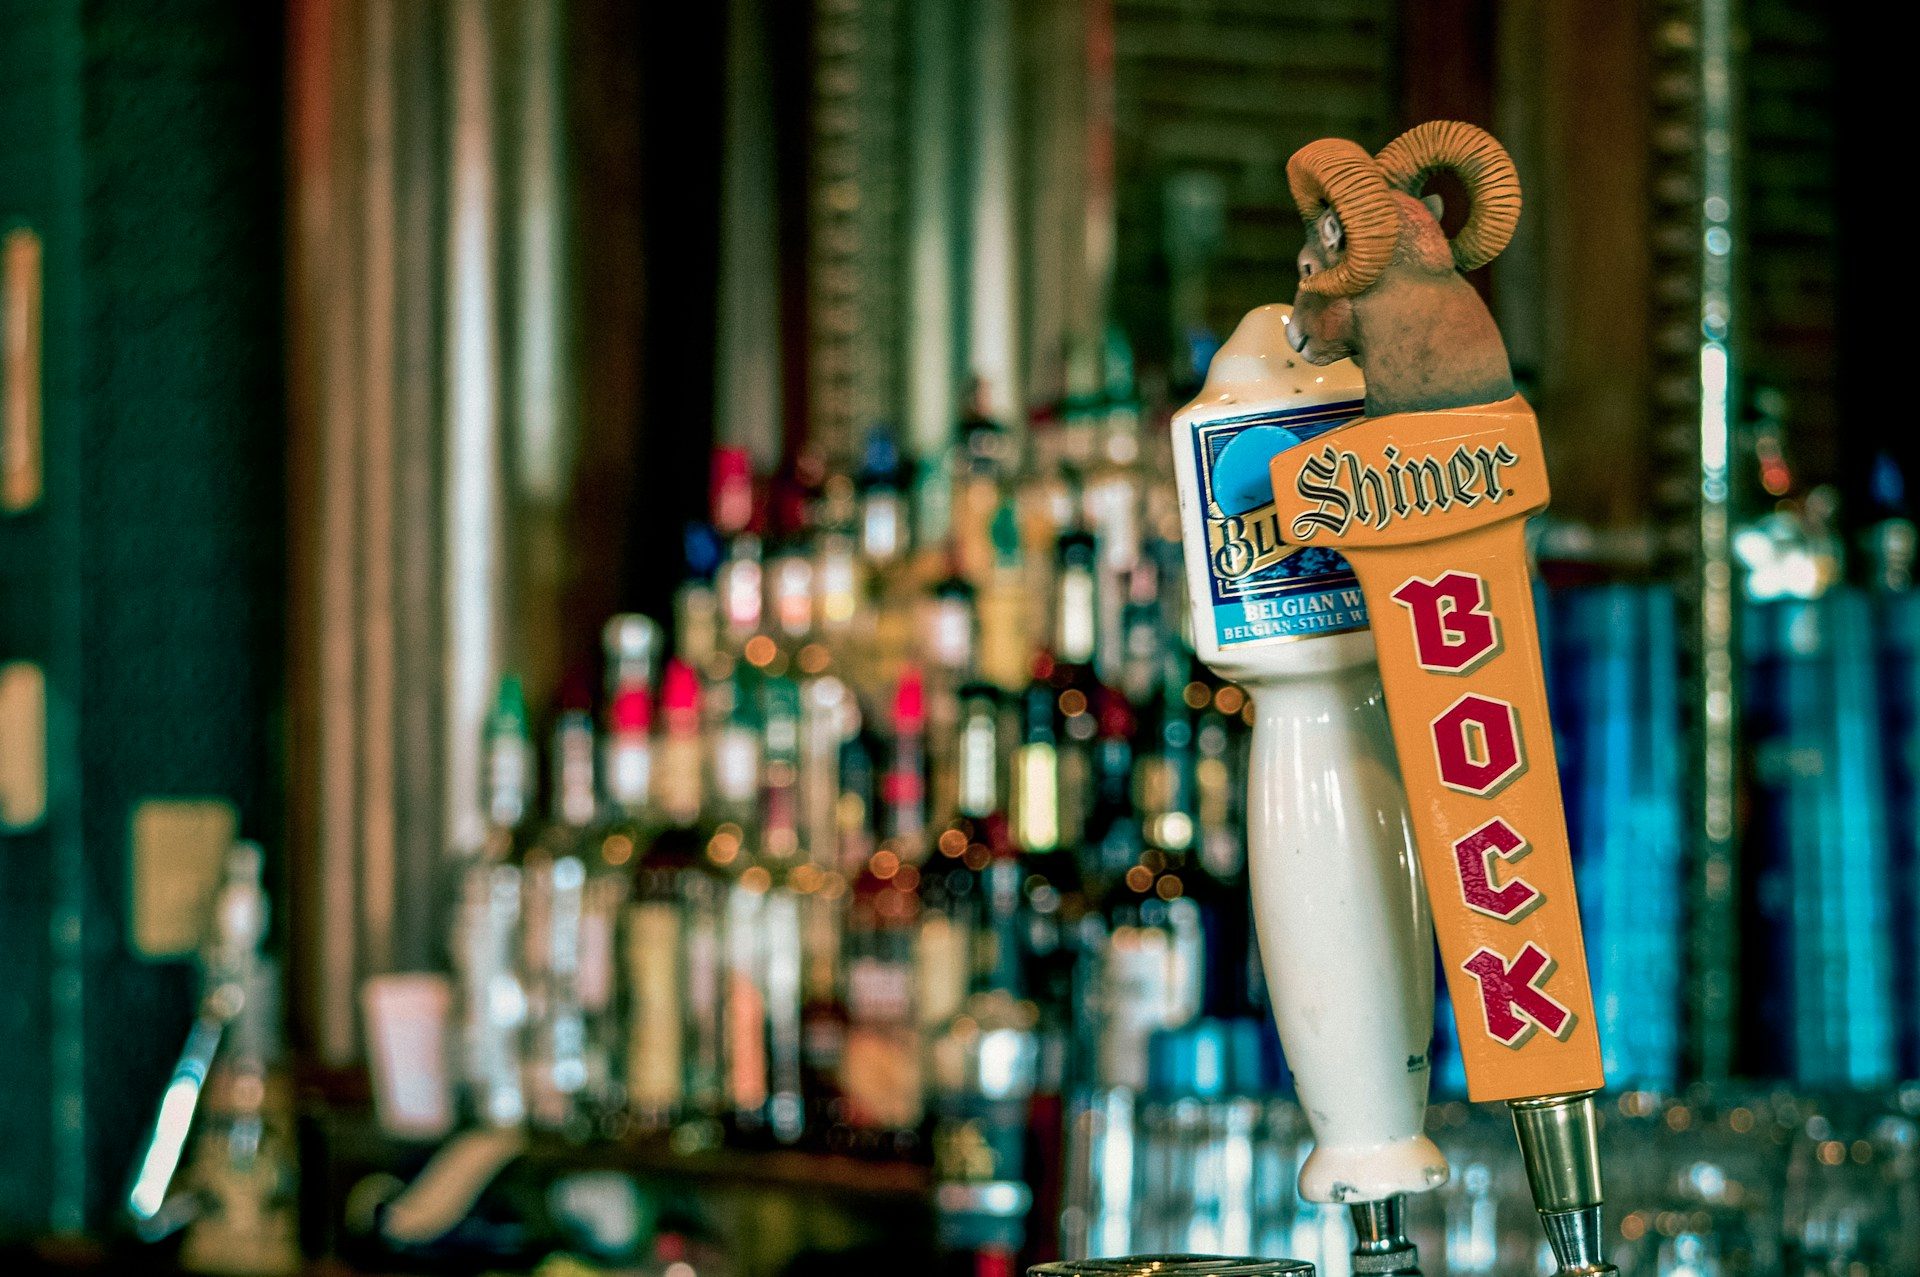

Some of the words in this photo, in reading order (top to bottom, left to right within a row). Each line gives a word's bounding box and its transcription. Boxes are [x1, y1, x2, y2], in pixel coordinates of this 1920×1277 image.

[1244, 594, 1335, 622] BELGIAN
[1340, 590, 1366, 608] W
[1224, 613, 1344, 640] BELGIAN-STYLE
[1390, 569, 1575, 1048] BOCK
